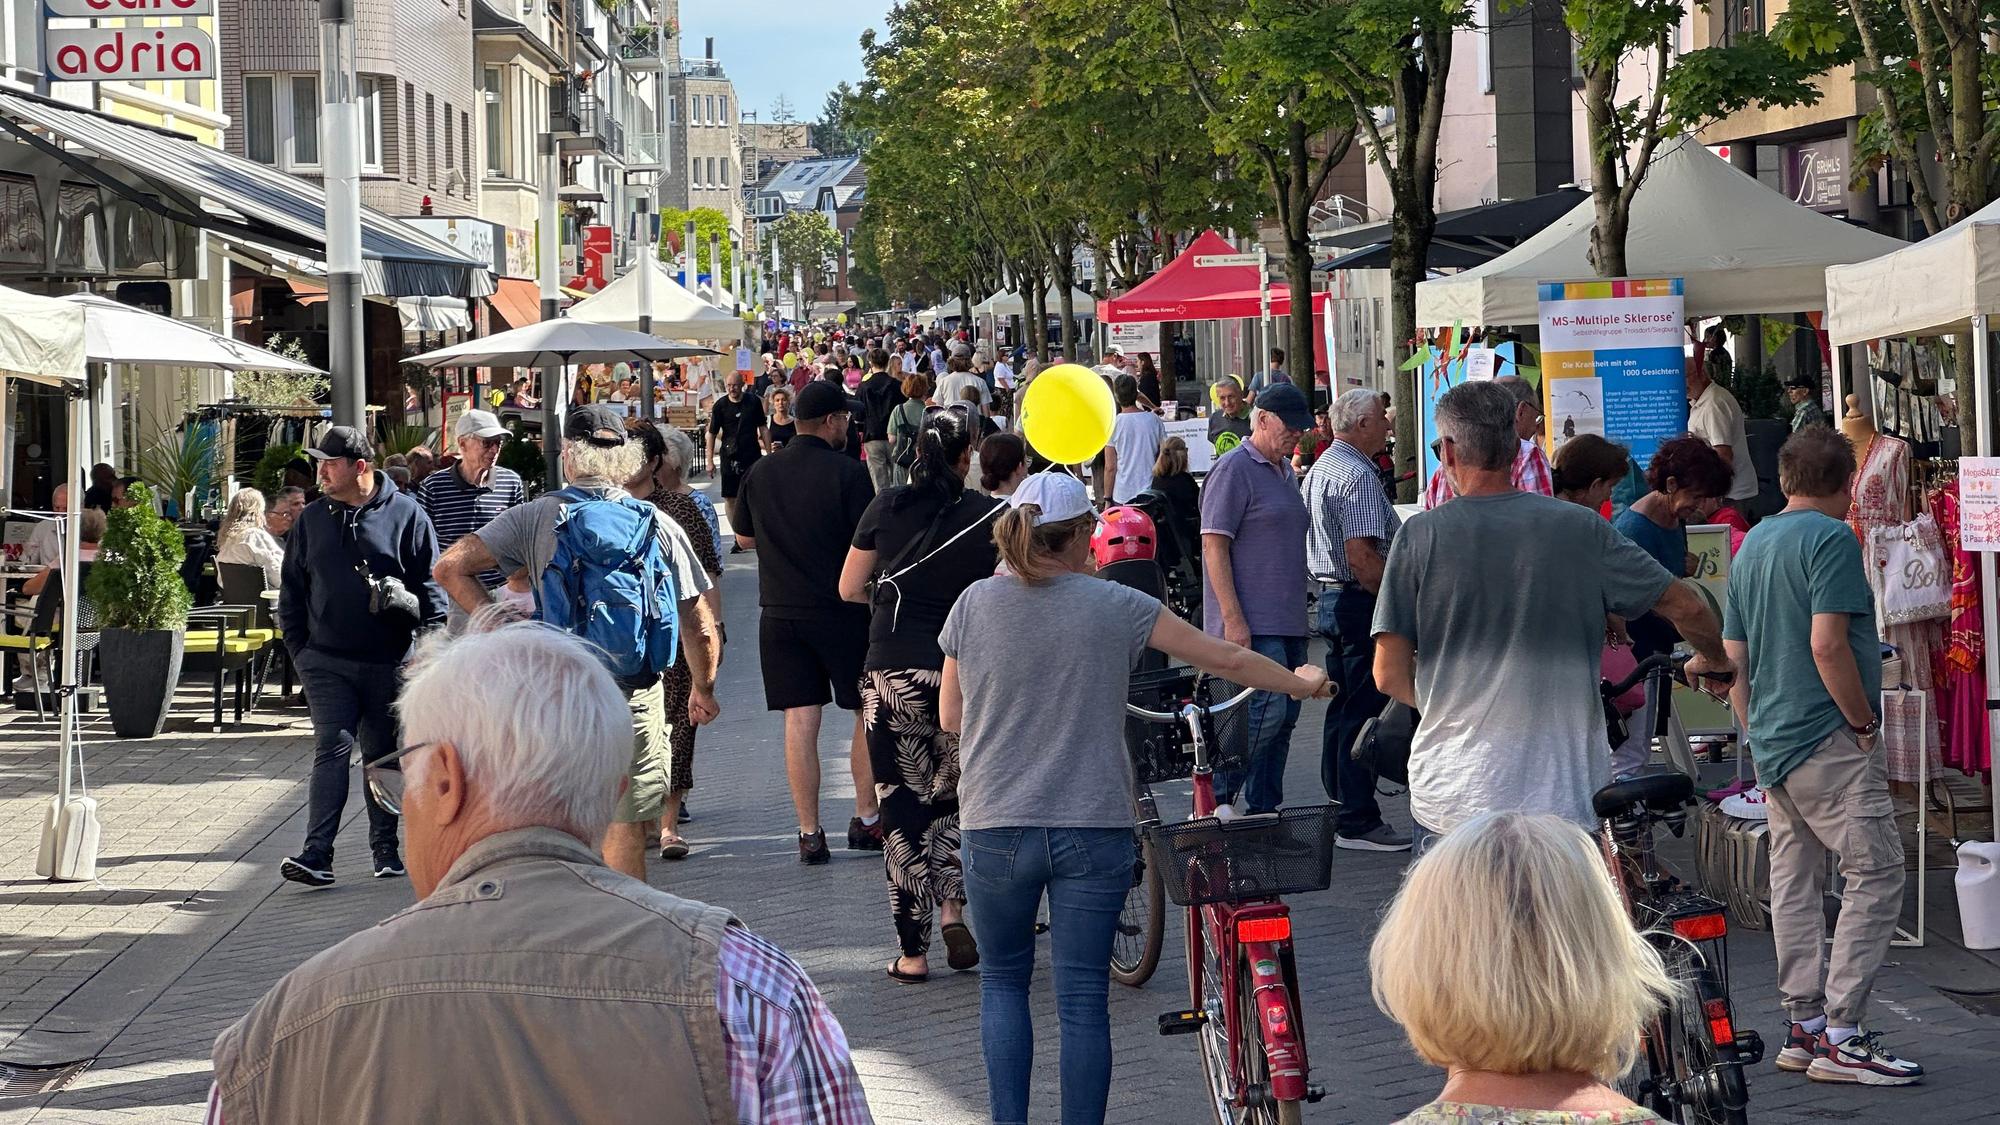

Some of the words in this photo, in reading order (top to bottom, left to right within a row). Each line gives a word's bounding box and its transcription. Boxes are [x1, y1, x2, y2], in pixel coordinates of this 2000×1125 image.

[57, 31, 202, 74] adria
[1575, 360, 1609, 369] Krankheit
[1622, 369, 1640, 377] 1000
[1641, 367, 1680, 376] Gesichtern
[1968, 512, 1983, 520] Paar
[1964, 523, 1969, 531] 2
[1969, 523, 1984, 531] Paar
[1964, 534, 1969, 543] 3
[1969, 534, 1984, 543] Paar
